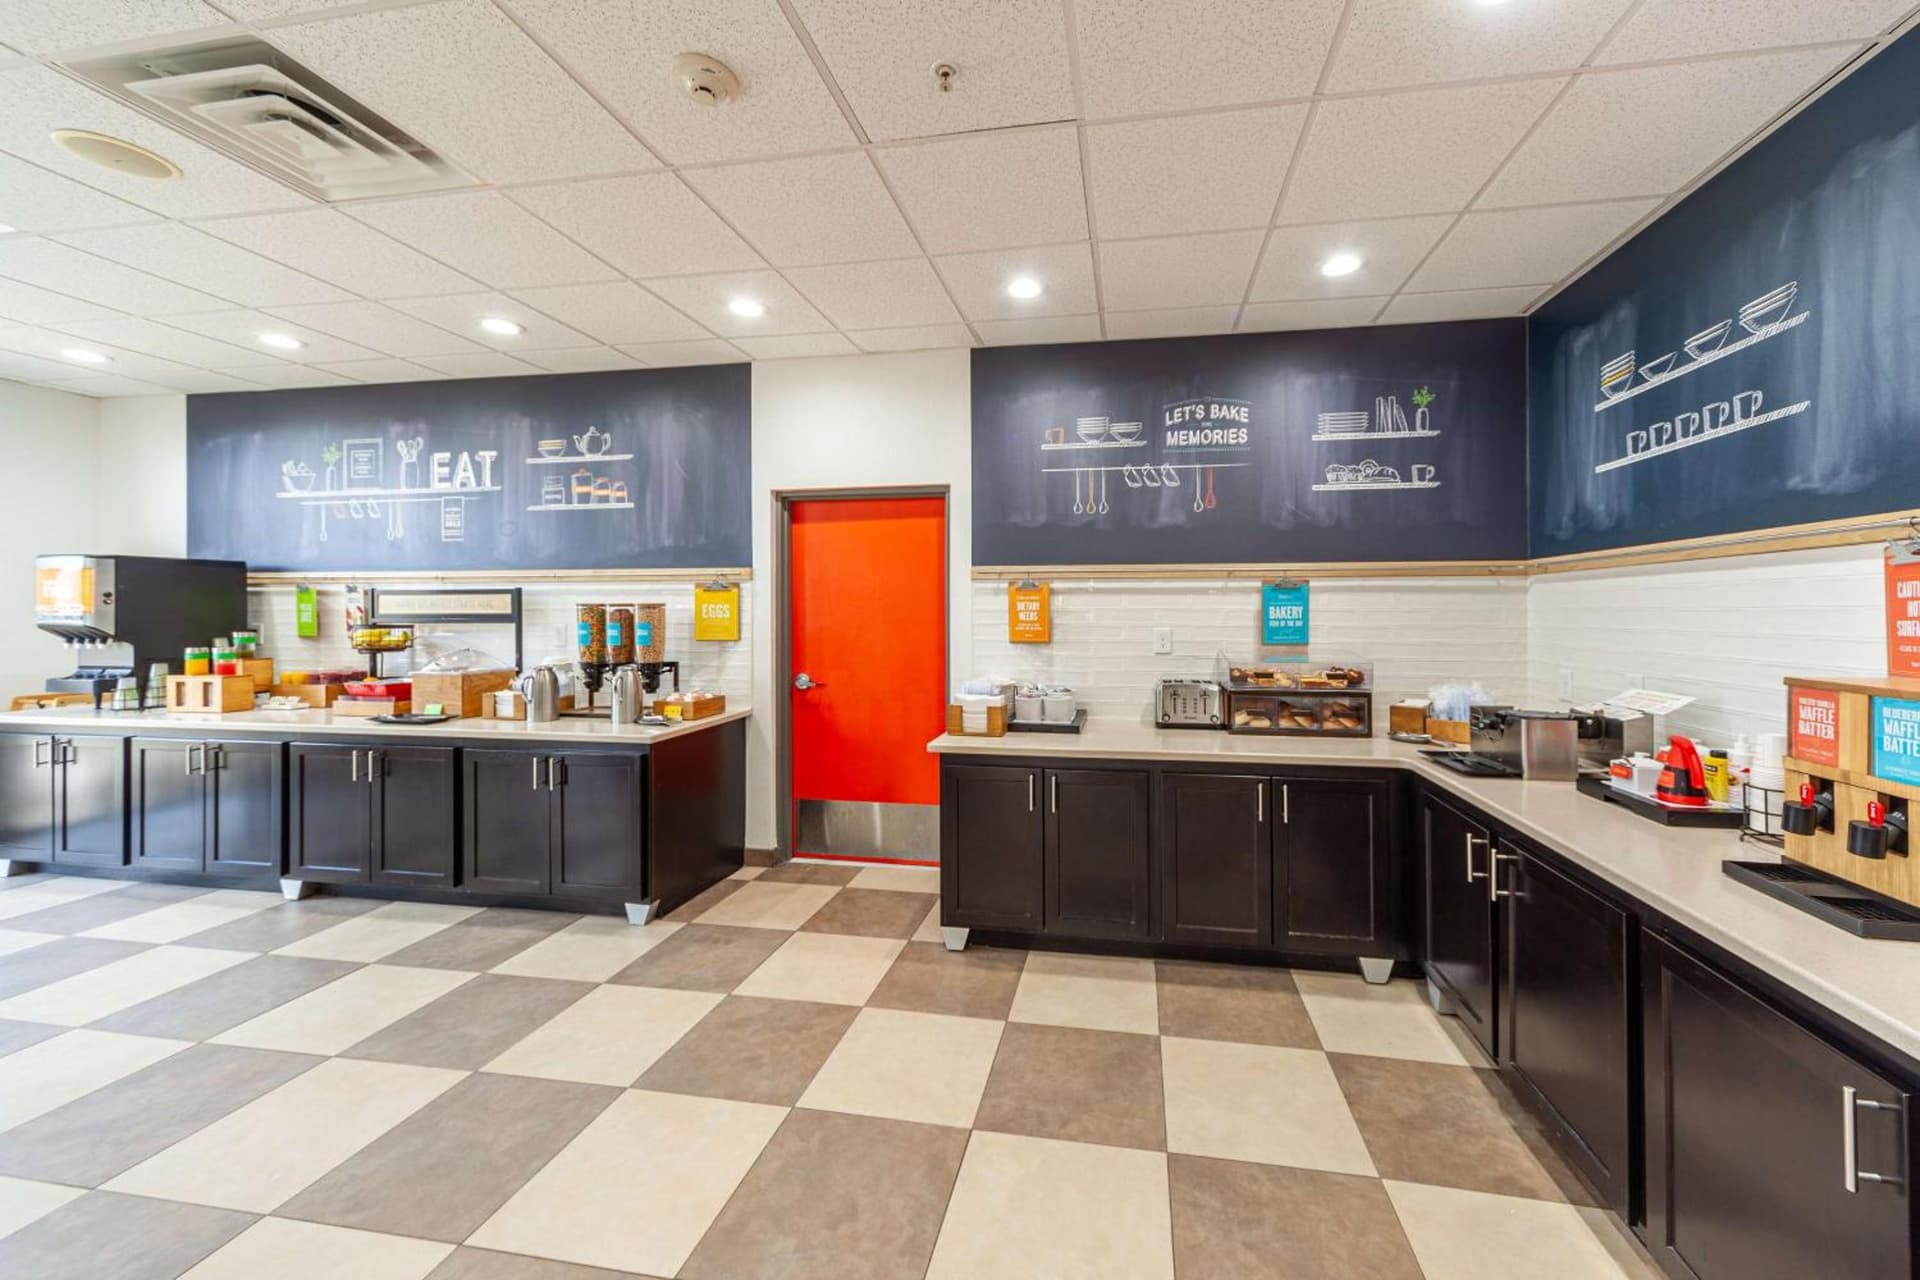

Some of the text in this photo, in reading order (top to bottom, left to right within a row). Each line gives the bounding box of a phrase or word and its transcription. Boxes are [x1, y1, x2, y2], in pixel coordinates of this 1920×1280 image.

[1165, 404, 1249, 426] LET'S BAKE
[1166, 428, 1248, 447] MEMORIES
[431, 451, 498, 489] EAT
[702, 603, 730, 618] EGGS
[1269, 606, 1303, 619] BAKERY
[1799, 704, 1835, 724] WAFFLE
[1798, 719, 1834, 740] BATTER
